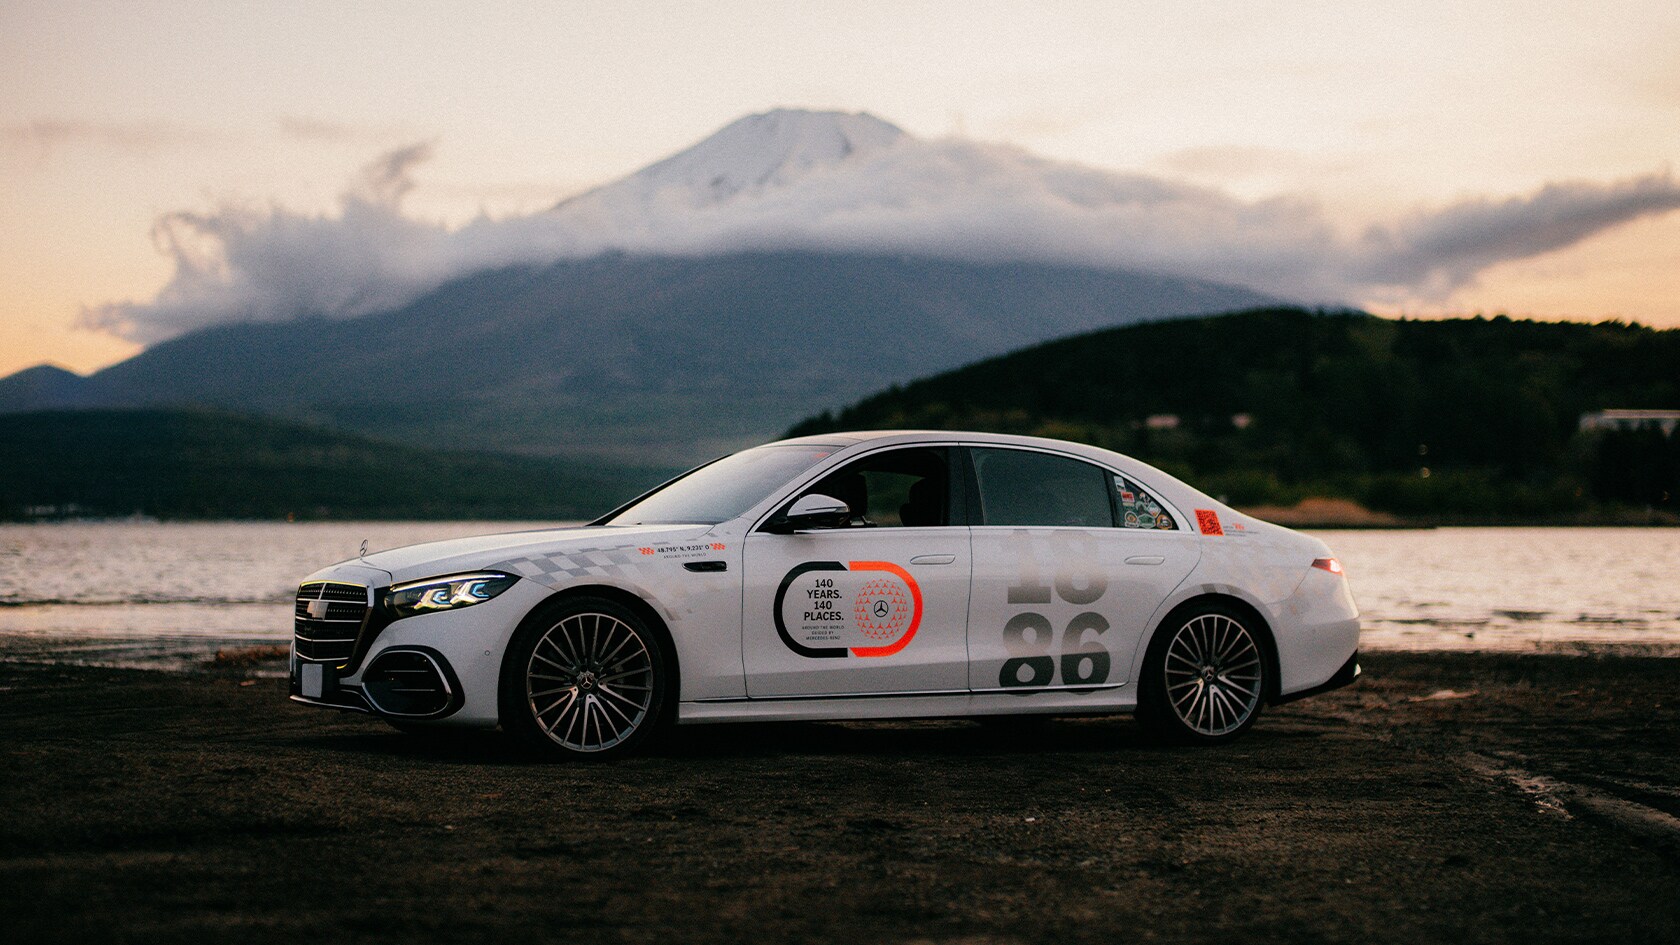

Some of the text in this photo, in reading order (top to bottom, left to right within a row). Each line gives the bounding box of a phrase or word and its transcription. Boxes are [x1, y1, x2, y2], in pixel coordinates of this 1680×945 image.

[815, 578, 834, 588] 140
[806, 589, 843, 599] YEARS.
[814, 600, 833, 610] 140
[804, 611, 844, 621] PLACES.
[998, 611, 1111, 695] 86
